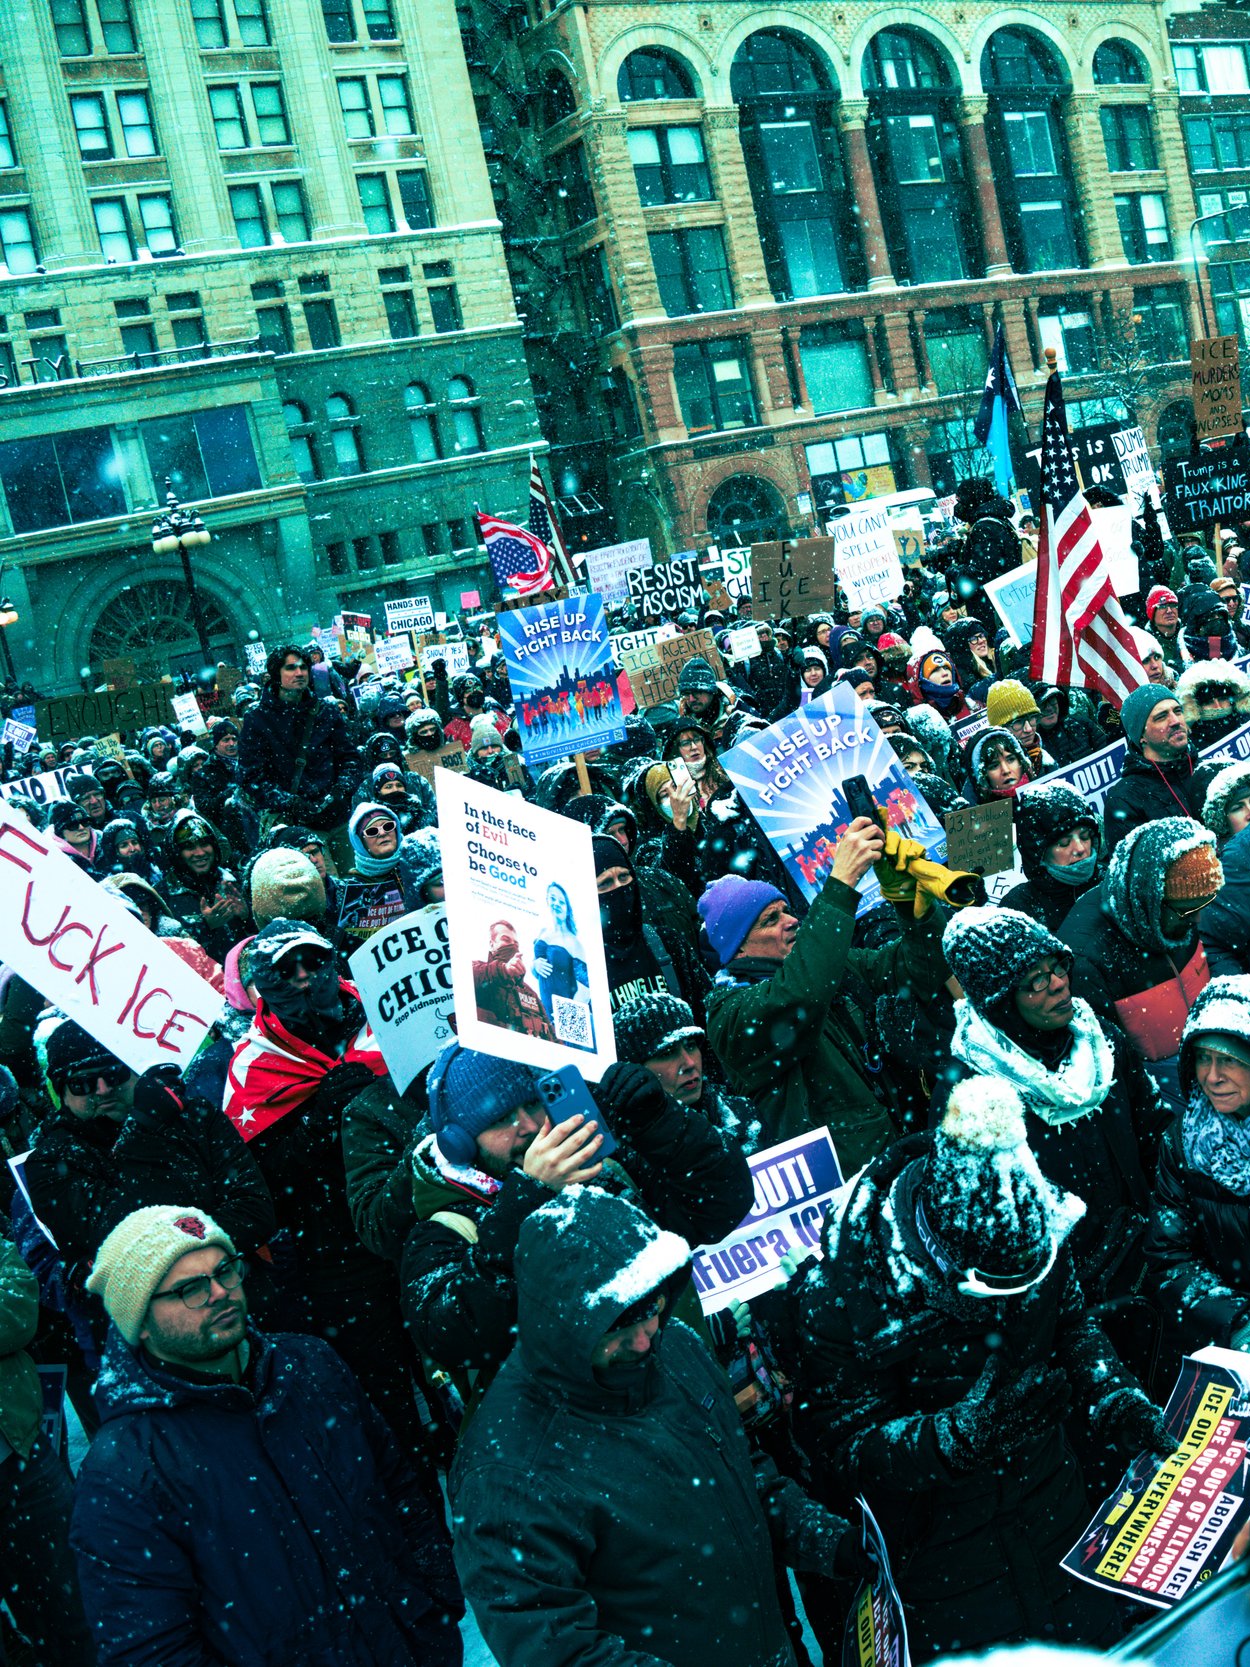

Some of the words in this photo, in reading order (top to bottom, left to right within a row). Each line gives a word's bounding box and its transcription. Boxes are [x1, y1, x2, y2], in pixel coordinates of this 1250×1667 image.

[1193, 362, 1240, 386] MURDERS
[1201, 386, 1234, 403] MOMS
[1198, 413, 1241, 433] NURSES
[1113, 426, 1145, 457] DUMP
[1120, 451, 1150, 480] TRUMP
[1177, 461, 1214, 479] Trump
[1218, 460, 1228, 470] is
[1233, 458, 1241, 467] a
[1175, 474, 1249, 500] FAUX-KING
[828, 522, 856, 544] YOU
[858, 511, 888, 536] CAN'T
[843, 540, 885, 560] SPELL
[627, 557, 698, 596] RESIST
[852, 569, 890, 588] WITHOUT
[387, 600, 414, 611] HANDS
[414, 597, 429, 607] OFF
[630, 584, 706, 619] FASCISM
[853, 583, 891, 606] ICE
[390, 615, 433, 631] CHICAGO
[523, 615, 561, 638] RISE
[564, 613, 587, 626] UP
[514, 634, 559, 661] FIGHT
[561, 628, 604, 645] BACK
[628, 650, 659, 672] ICE
[661, 631, 713, 660] AGENTS
[48, 687, 169, 737] ENOUGH!
[759, 730, 809, 773] RISE
[810, 714, 843, 741] UP
[959, 723, 983, 740] ABOLISH
[758, 752, 813, 807] FIGHT
[814, 726, 874, 763] BACK
[1072, 755, 1117, 795] OUT!
[464, 802, 480, 820] In
[482, 810, 506, 830] the
[507, 819, 537, 842] face
[465, 822, 481, 836] of
[482, 825, 508, 847] Evil
[467, 840, 522, 871] Choose
[522, 860, 539, 878] to
[469, 856, 488, 875] be
[489, 862, 528, 890] Good
[0, 823, 125, 1007] FUCK
[371, 926, 427, 973] ICE
[117, 964, 209, 1053] ICE
[394, 1010, 411, 1027] Stop
[750, 1154, 818, 1216] OUT!
[1205, 1376, 1235, 1410] ICE
[1185, 1414, 1215, 1448] OUT
[1212, 1417, 1236, 1445] ICE
[1168, 1448, 1193, 1475] OF
[1190, 1444, 1218, 1477] OUT
[1218, 1439, 1245, 1468] ICE
[1176, 1473, 1200, 1500] OF
[1199, 1464, 1230, 1500] OUT
[1099, 1468, 1179, 1586] EVERYWHERE!
[1184, 1498, 1209, 1525] OF
[1189, 1490, 1245, 1566] ABOLISH
[1123, 1496, 1185, 1587] MINNESOTA
[1141, 1522, 1195, 1597] ILLINOIS
[1166, 1558, 1204, 1604] ICE!
